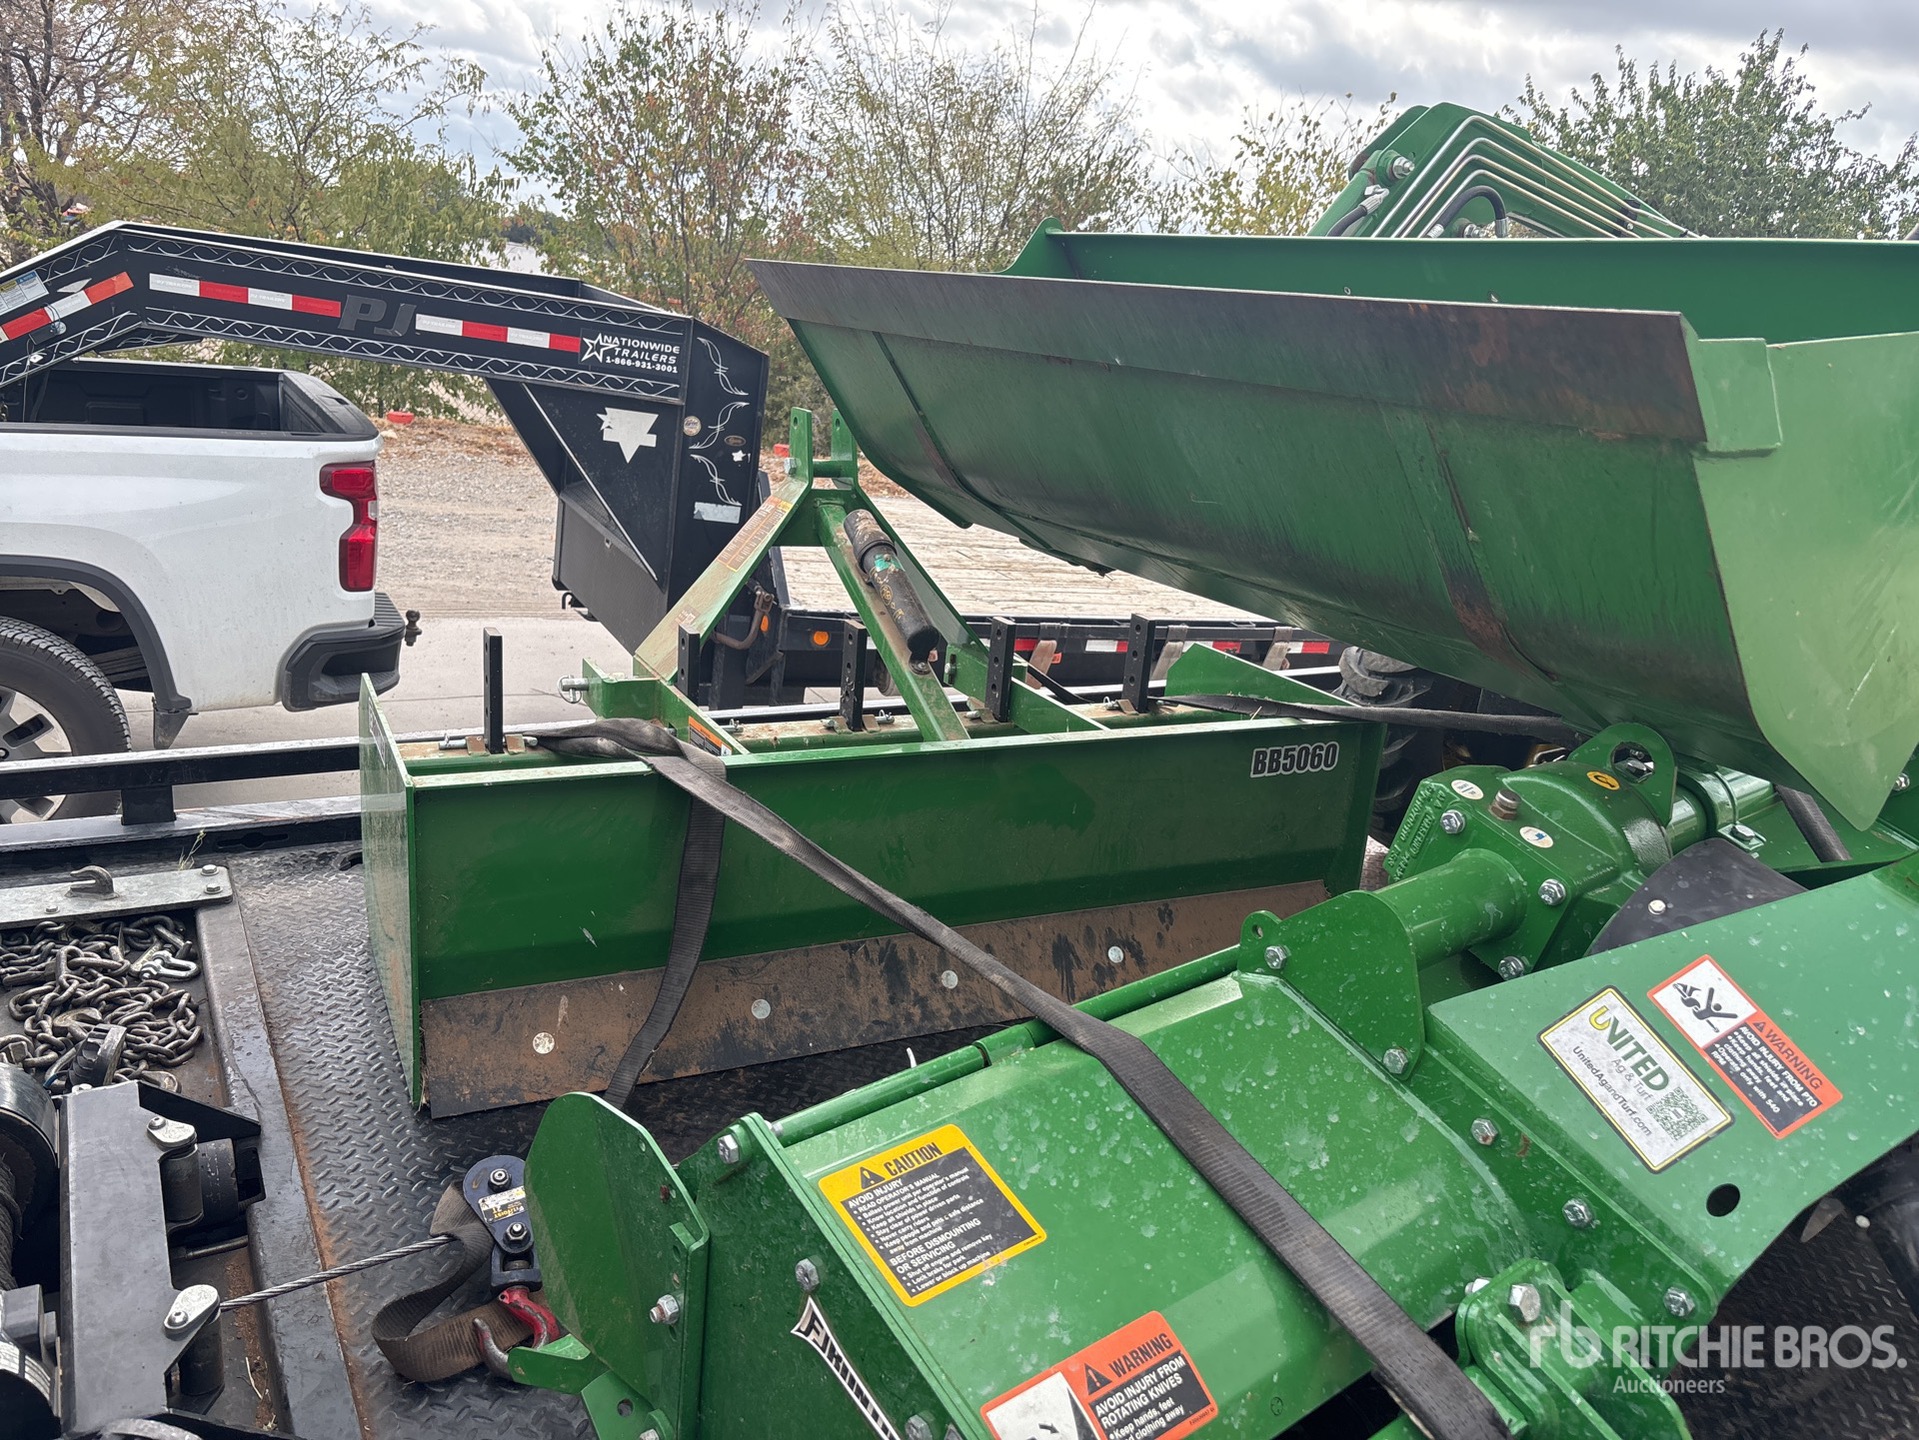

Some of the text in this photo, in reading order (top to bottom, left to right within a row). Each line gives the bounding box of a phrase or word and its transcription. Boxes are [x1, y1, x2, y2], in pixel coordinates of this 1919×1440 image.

[337, 294, 417, 337] PJ
[603, 335, 680, 354] NATIONWIDE
[613, 347, 677, 365] TRAILERS
[605, 356, 678, 374] 1-866-931-3001
[1251, 742, 1338, 776] BB5060
[1589, 1006, 1669, 1089] UNITED
[1711, 1050, 1727, 1066] RPM
[1723, 1043, 1748, 1068] clothing
[1739, 1026, 1818, 1107] AVOID INJURY FROM PTO
[1751, 1051, 1762, 1060] all
[1765, 1025, 1823, 1095] WARNING
[1573, 1046, 1652, 1136] UnitedAgandTurf.com
[1610, 1058, 1654, 1101] Ag & Turf
[1739, 1071, 1754, 1086] only
[1752, 1085, 1767, 1100] with
[1765, 1098, 1781, 1113] 540
[1776, 1089, 1791, 1103] and
[883, 1142, 943, 1176] CAUTION
[848, 1178, 903, 1209] AVOID INJURY
[857, 1201, 877, 1213] READ
[913, 1173, 940, 1187] MANUAL
[862, 1206, 884, 1219] Ballast
[882, 1198, 901, 1211] power
[900, 1192, 913, 1202] unit
[911, 1188, 922, 1197] per
[948, 1166, 969, 1179] manual
[883, 1203, 908, 1217] location
[907, 1197, 919, 1207] and
[917, 1187, 941, 1201] function
[940, 1183, 948, 1191] of
[947, 1174, 970, 1188] controls
[870, 1220, 888, 1231] Keep
[887, 1215, 896, 1224] all
[894, 1207, 917, 1220] shields
[922, 1196, 939, 1208] place
[875, 1194, 961, 1237] Stay clear of power driven parts
[879, 1216, 930, 1242] Never carry riders
[883, 1238, 901, 1249] Keep
[900, 1228, 921, 1242] people
[919, 1222, 932, 1232] and
[931, 1217, 944, 1227] pets
[948, 1209, 961, 1218] safe
[960, 1198, 984, 1212] distance
[889, 1218, 981, 1266] BEFORE DISMOUNTING
[903, 1237, 920, 1247] from
[918, 1225, 943, 1240] machine
[906, 1233, 993, 1279] Shut off engine and remove key
[896, 1241, 956, 1274] OR SERVICING
[911, 1255, 966, 1285] Lock brake for park
[915, 1278, 935, 1291] Lower
[941, 1267, 959, 1278] block
[1108, 1333, 1174, 1378] WARNING
[1095, 1355, 1186, 1417] AVOID INJURY FROM
[1097, 1393, 1150, 1429] ROTATING
[1145, 1372, 1183, 1400] KNIVES
[1113, 1422, 1135, 1440] Keep
[1158, 1396, 1175, 1412] feet
[1132, 1416, 1167, 1440] clothing
[1164, 1404, 1185, 1422] away
